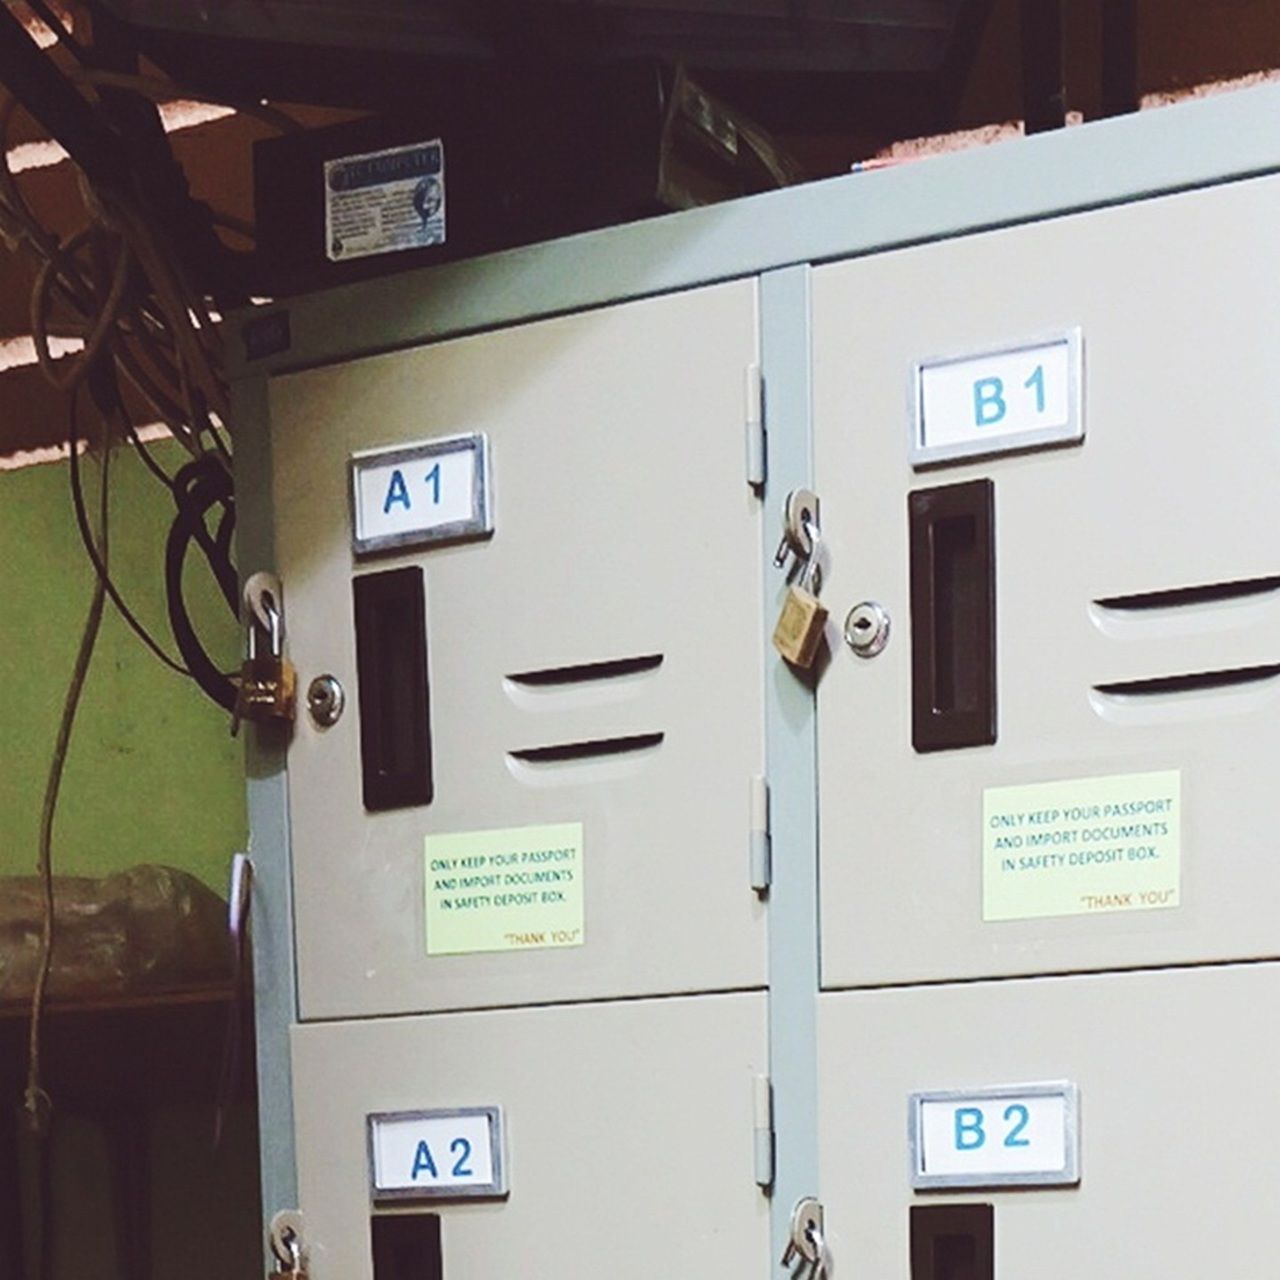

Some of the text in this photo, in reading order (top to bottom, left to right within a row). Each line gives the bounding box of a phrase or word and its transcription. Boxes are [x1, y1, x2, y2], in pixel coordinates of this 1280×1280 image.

[990, 798, 1172, 828] ONLY KEEP YOUR PASSPORT
[994, 822, 1167, 849] AND IMPORT DOCUMENTS
[430, 848, 575, 870] ONLY KEEP YOUR PASSPORT
[1001, 845, 1159, 871] IN SAFETY DEPOSIT BOX.
[433, 869, 573, 890] AND IMPORT DOCUMENTS
[440, 898, 451, 910] IN
[454, 895, 490, 909] SAFETY
[493, 892, 537, 906] DEPOSIT
